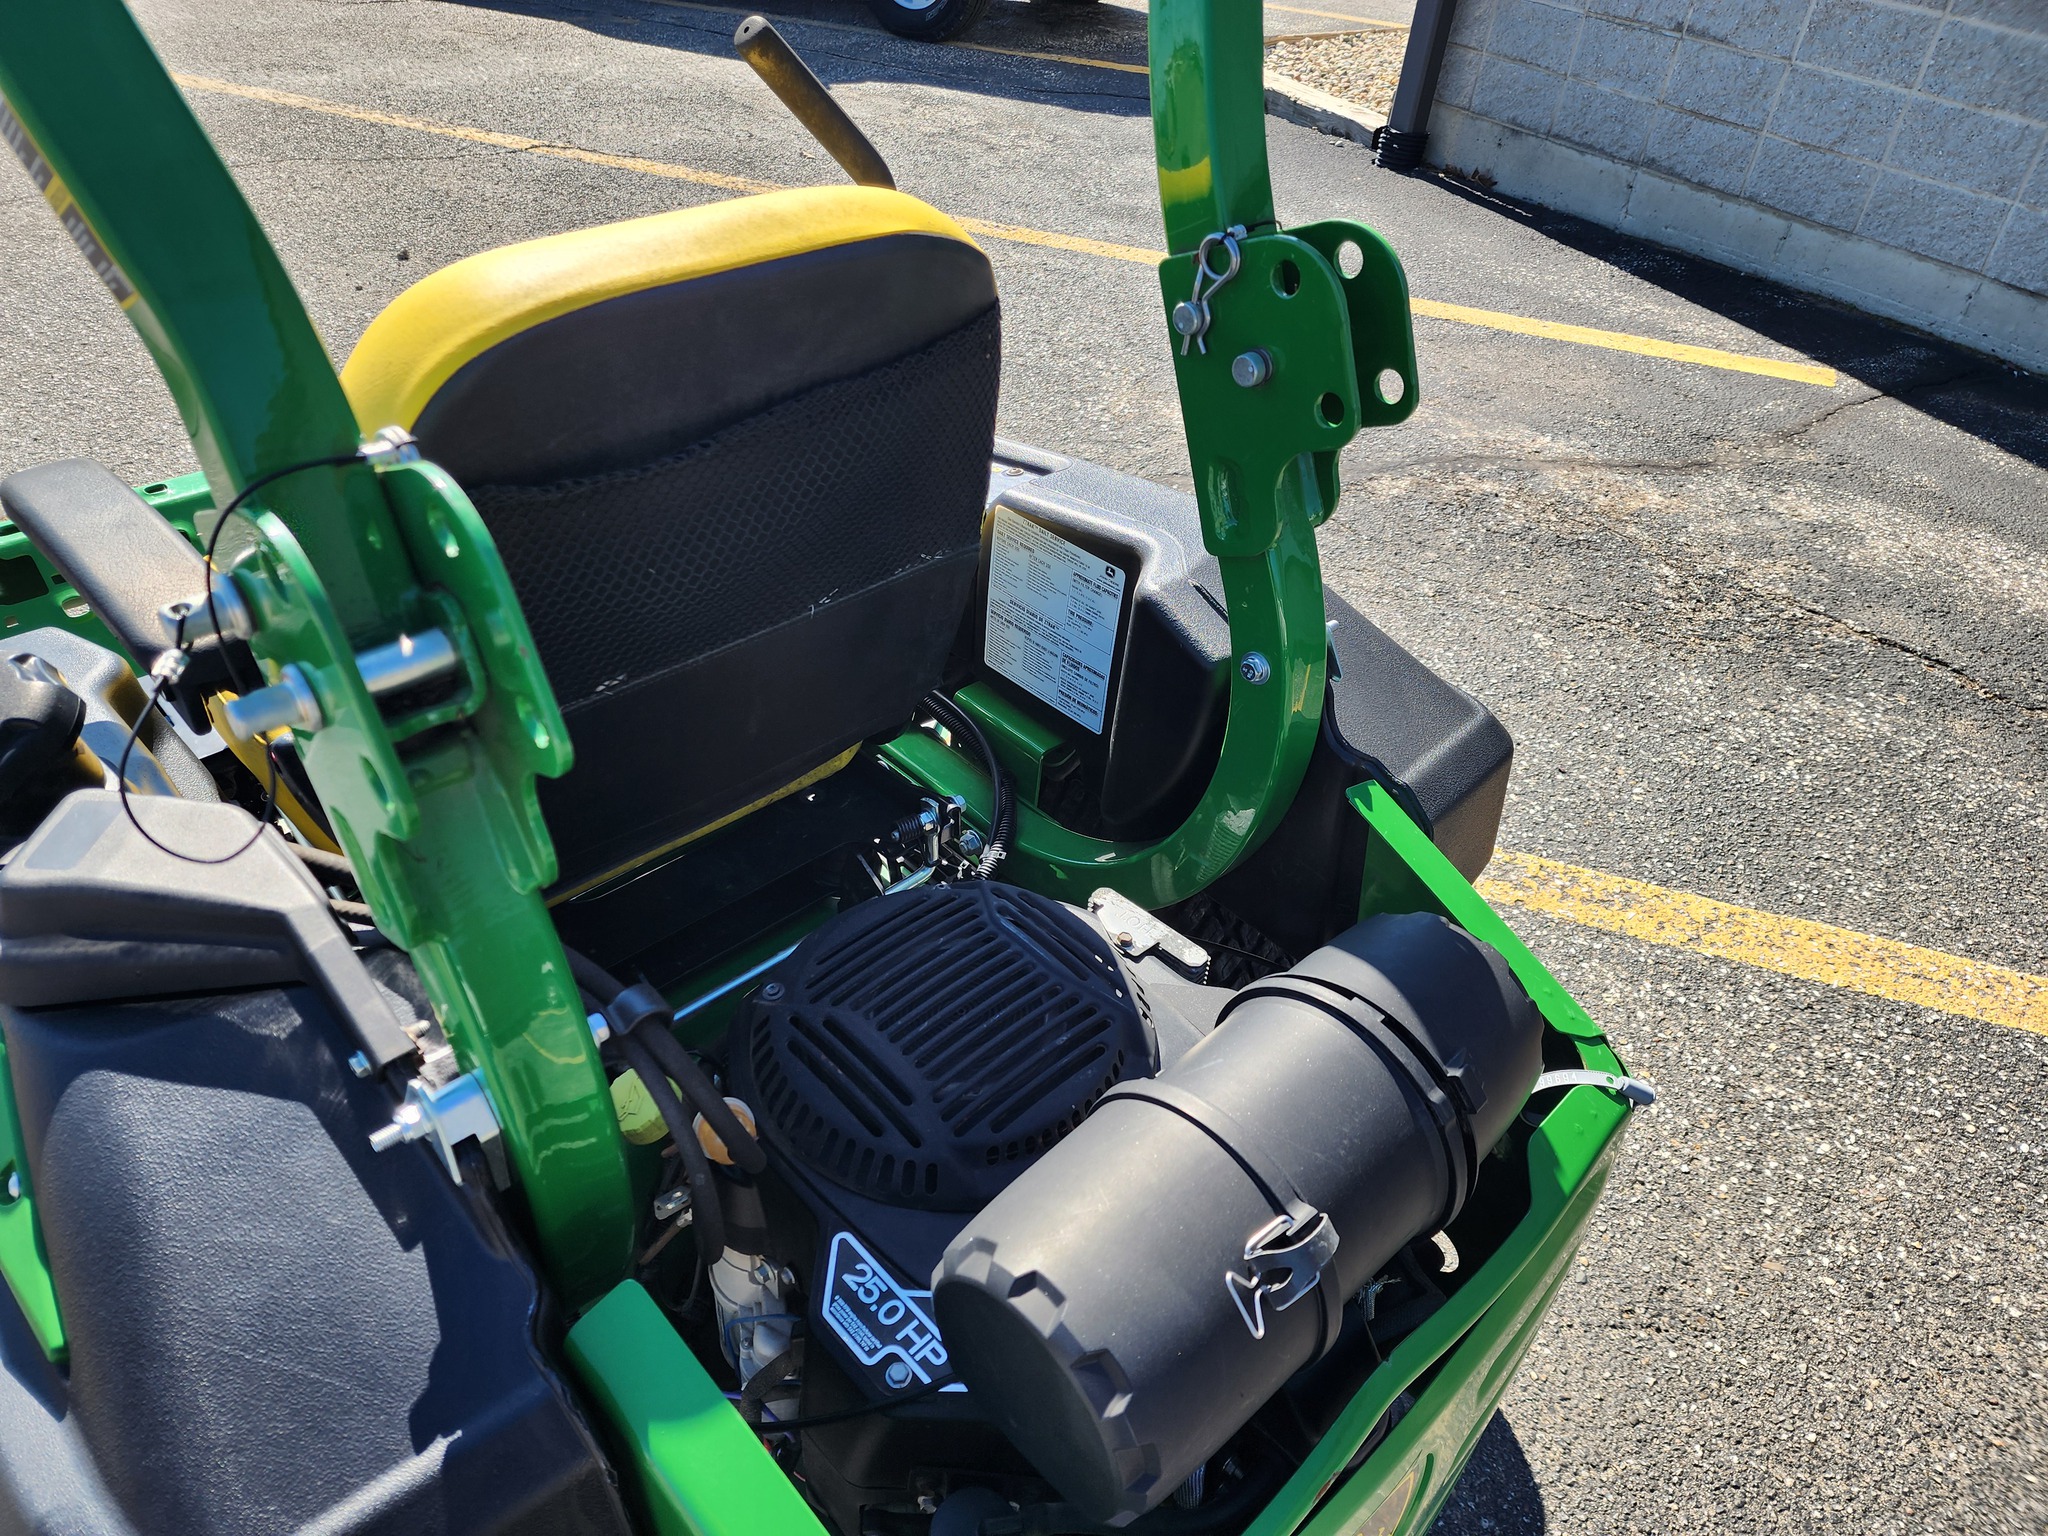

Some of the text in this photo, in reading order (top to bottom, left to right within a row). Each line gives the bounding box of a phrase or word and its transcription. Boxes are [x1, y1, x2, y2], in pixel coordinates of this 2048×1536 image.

[1049, 533, 1065, 546] SERVICE
[841, 1263, 906, 1326] 25.0
[895, 1320, 948, 1366] HP
